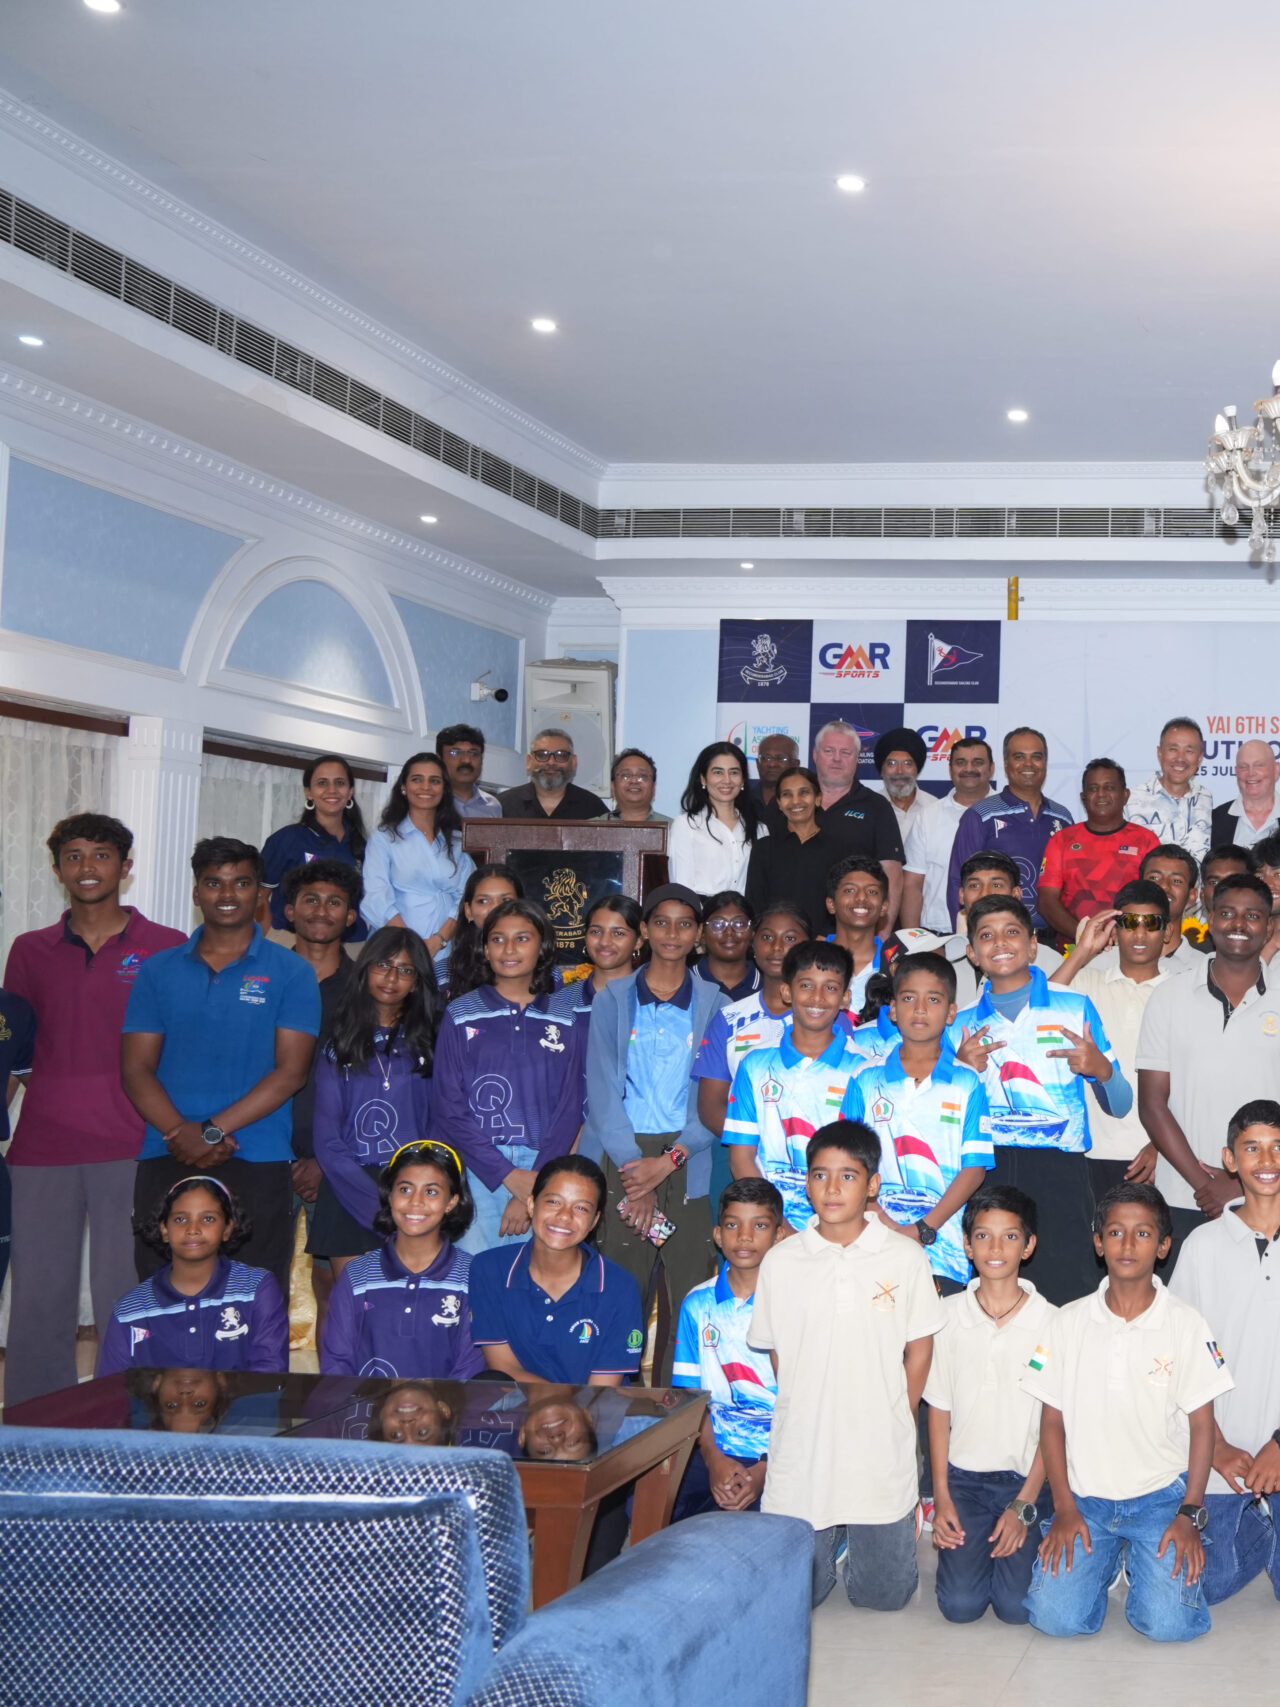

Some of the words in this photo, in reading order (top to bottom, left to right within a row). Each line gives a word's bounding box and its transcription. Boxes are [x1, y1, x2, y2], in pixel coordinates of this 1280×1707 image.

[835, 670, 880, 678] SPORTS
[1206, 716, 1230, 734] YAI
[1235, 716, 1266, 734] 6TH
[752, 726, 789, 735] YACHTING
[556, 941, 575, 949] 1878
